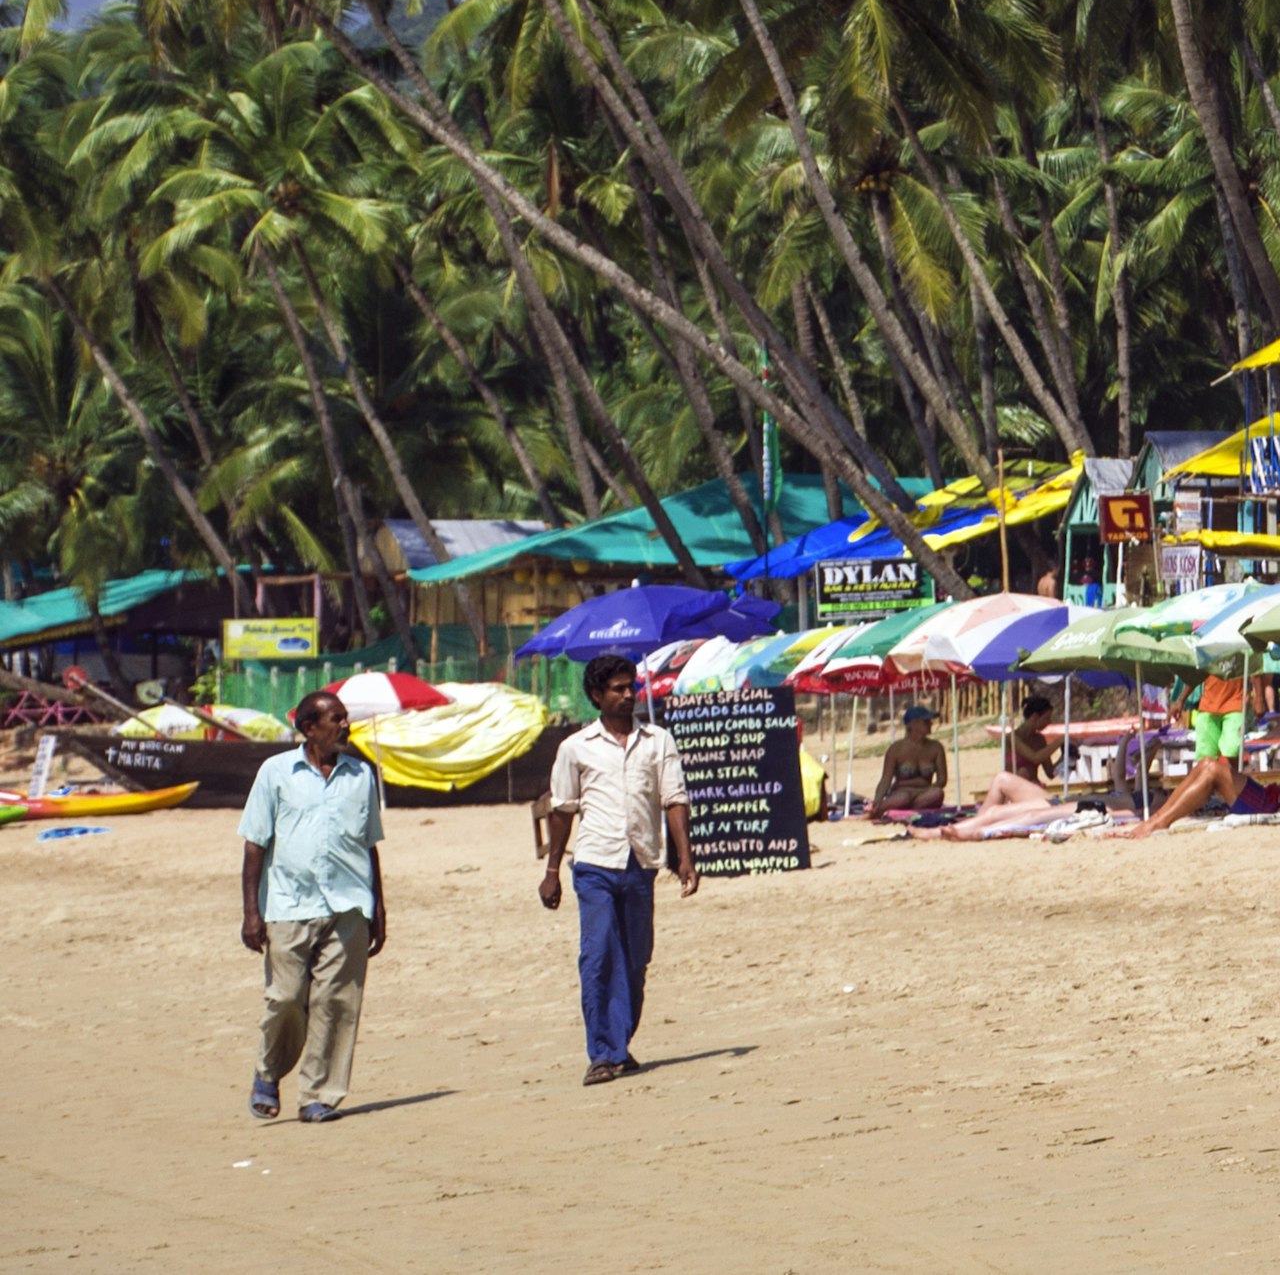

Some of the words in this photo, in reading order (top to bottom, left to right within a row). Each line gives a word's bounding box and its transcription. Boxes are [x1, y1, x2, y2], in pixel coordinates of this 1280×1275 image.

[1107, 531, 1149, 541] TABOS
[823, 562, 918, 586] DYLAN
[852, 581, 918, 593] RESTAURANT
[664, 691, 714, 709] TODAY'S
[717, 688, 773, 704] SPECIAL
[671, 704, 729, 721] AVOCADO
[731, 701, 776, 716] SALAD
[673, 722, 723, 737] SHRIMP
[725, 718, 762, 731] COMBO
[677, 733, 730, 751] SEAFOOD
[733, 731, 766, 744] SOUP
[730, 747, 766, 762] WRAP
[684, 770, 714, 782] UNA
[717, 766, 759, 779] STEAK
[687, 786, 726, 801] HARK
[727, 781, 783, 797] GRILLED
[689, 804, 708, 820] ED
[712, 799, 771, 815] SNAPPER
[689, 822, 715, 838] URF
[734, 820, 770, 834] TURF
[768, 838, 798, 852] AND
[695, 857, 740, 873] PINACH
[742, 856, 799, 870] WRAPPED
